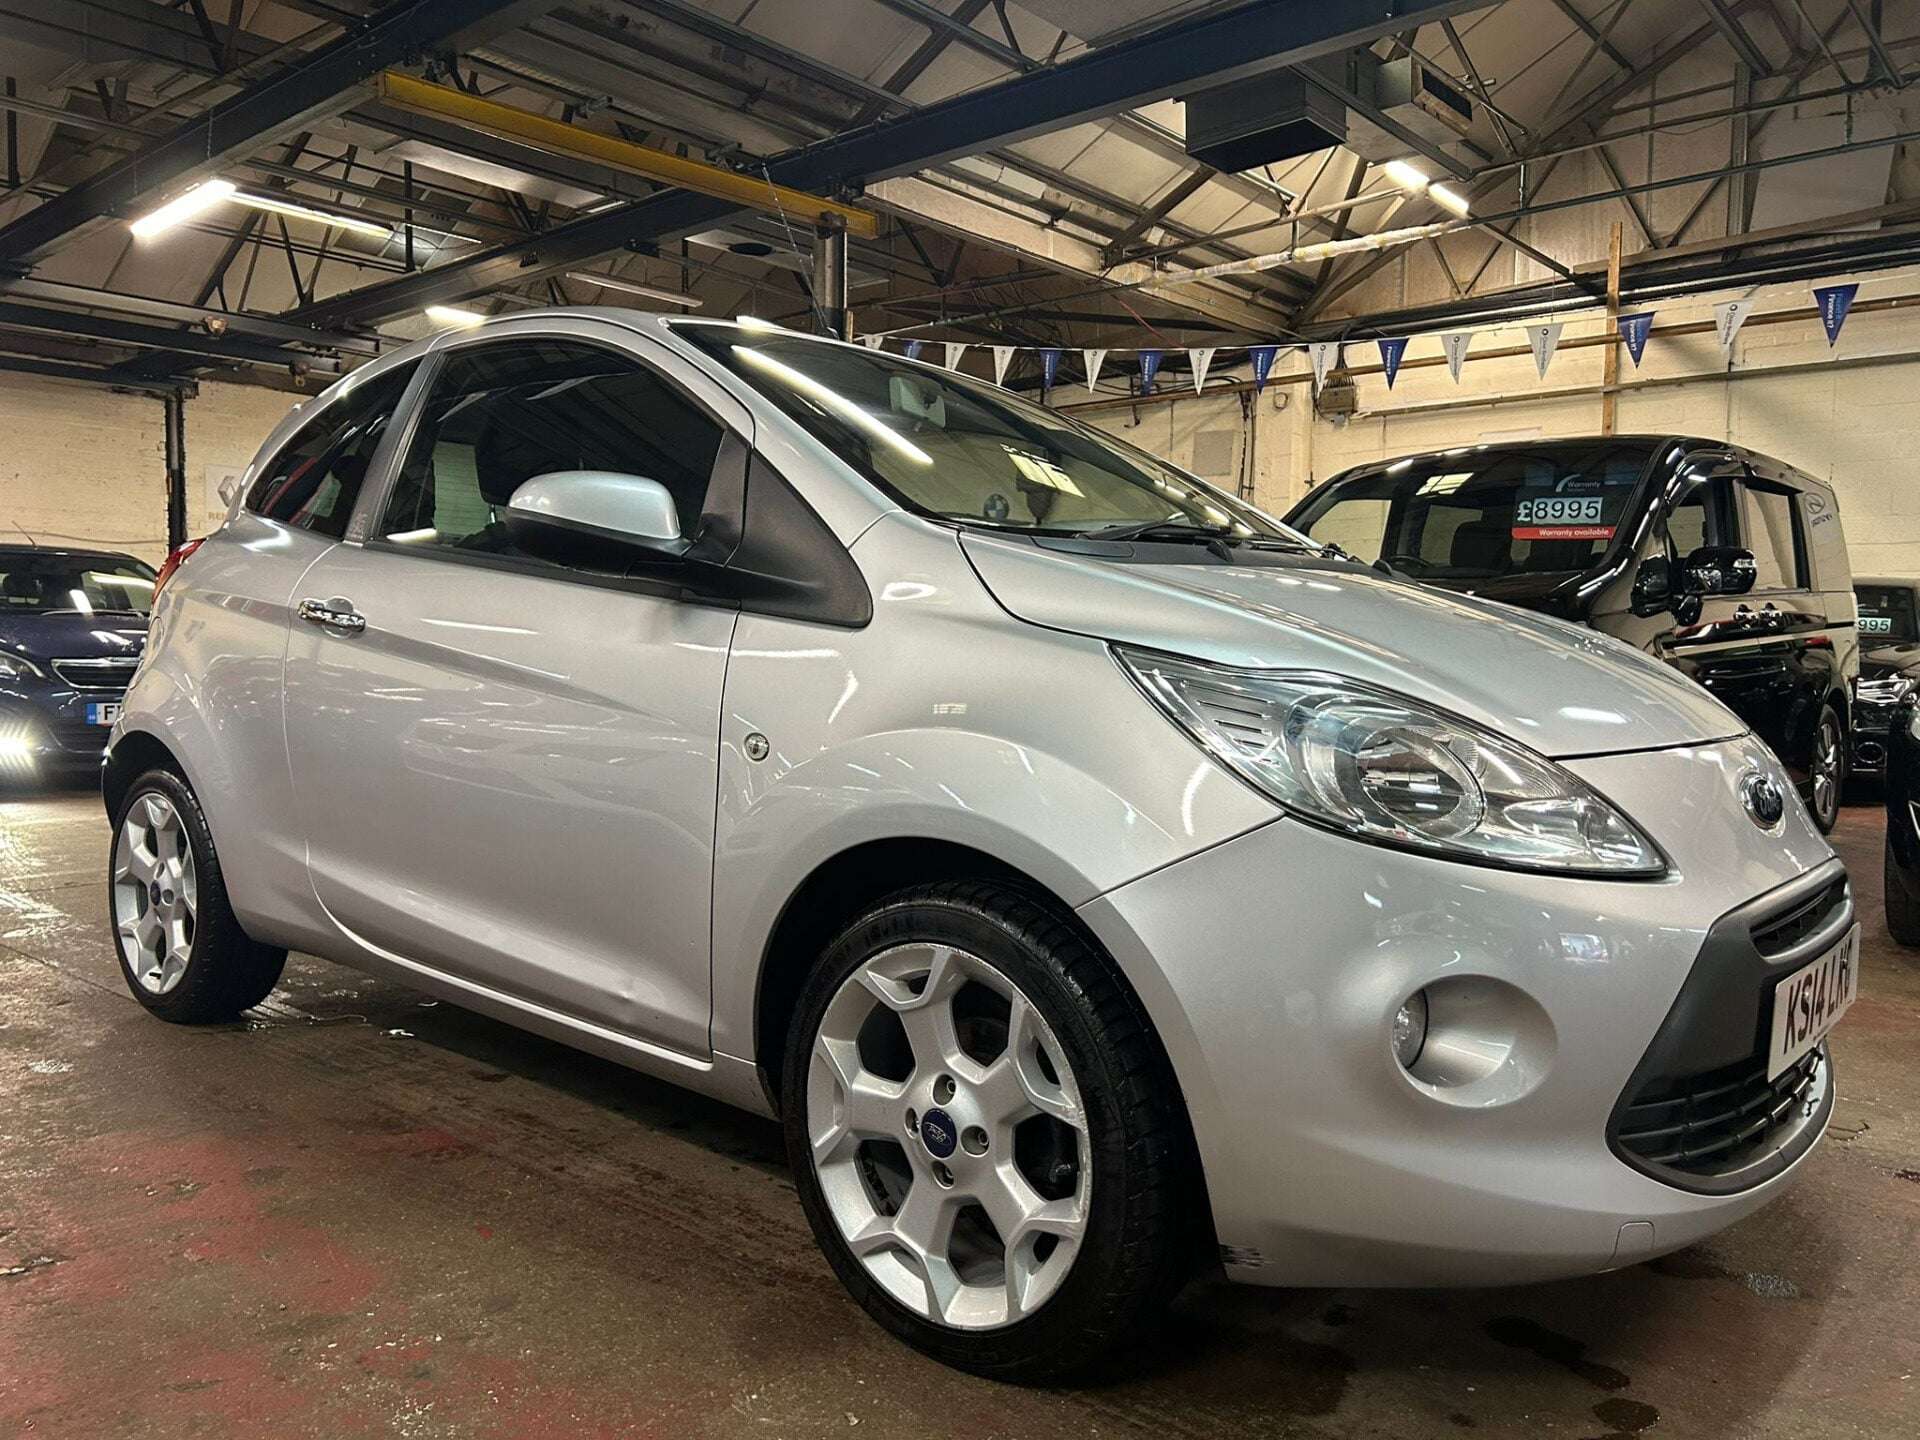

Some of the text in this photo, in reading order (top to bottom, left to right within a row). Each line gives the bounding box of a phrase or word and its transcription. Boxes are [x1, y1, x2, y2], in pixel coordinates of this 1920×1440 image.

[1567, 480, 1601, 489] Warranty
[1517, 500, 1600, 521] £8995
[1539, 527, 1609, 538] Warranty available
[1784, 961, 1828, 1055] KS14
